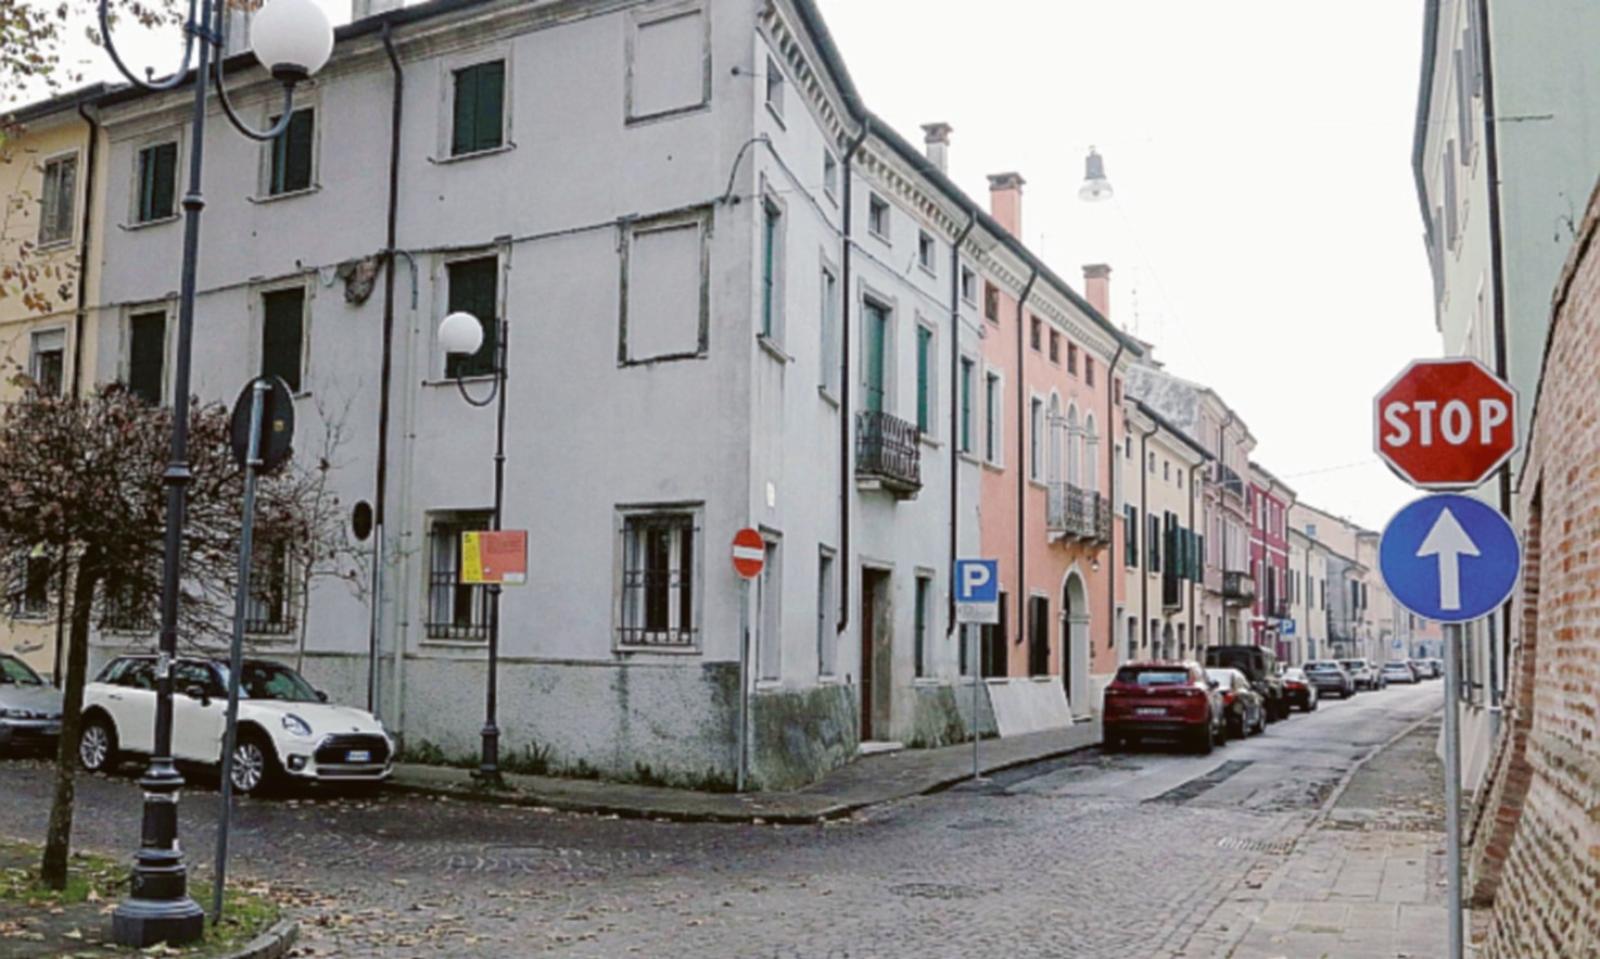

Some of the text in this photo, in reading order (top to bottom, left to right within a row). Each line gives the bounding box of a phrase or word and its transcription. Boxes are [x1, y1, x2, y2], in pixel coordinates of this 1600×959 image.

[1384, 398, 1508, 447] STOP
[963, 563, 990, 597] P
[1282, 620, 1293, 634] P
